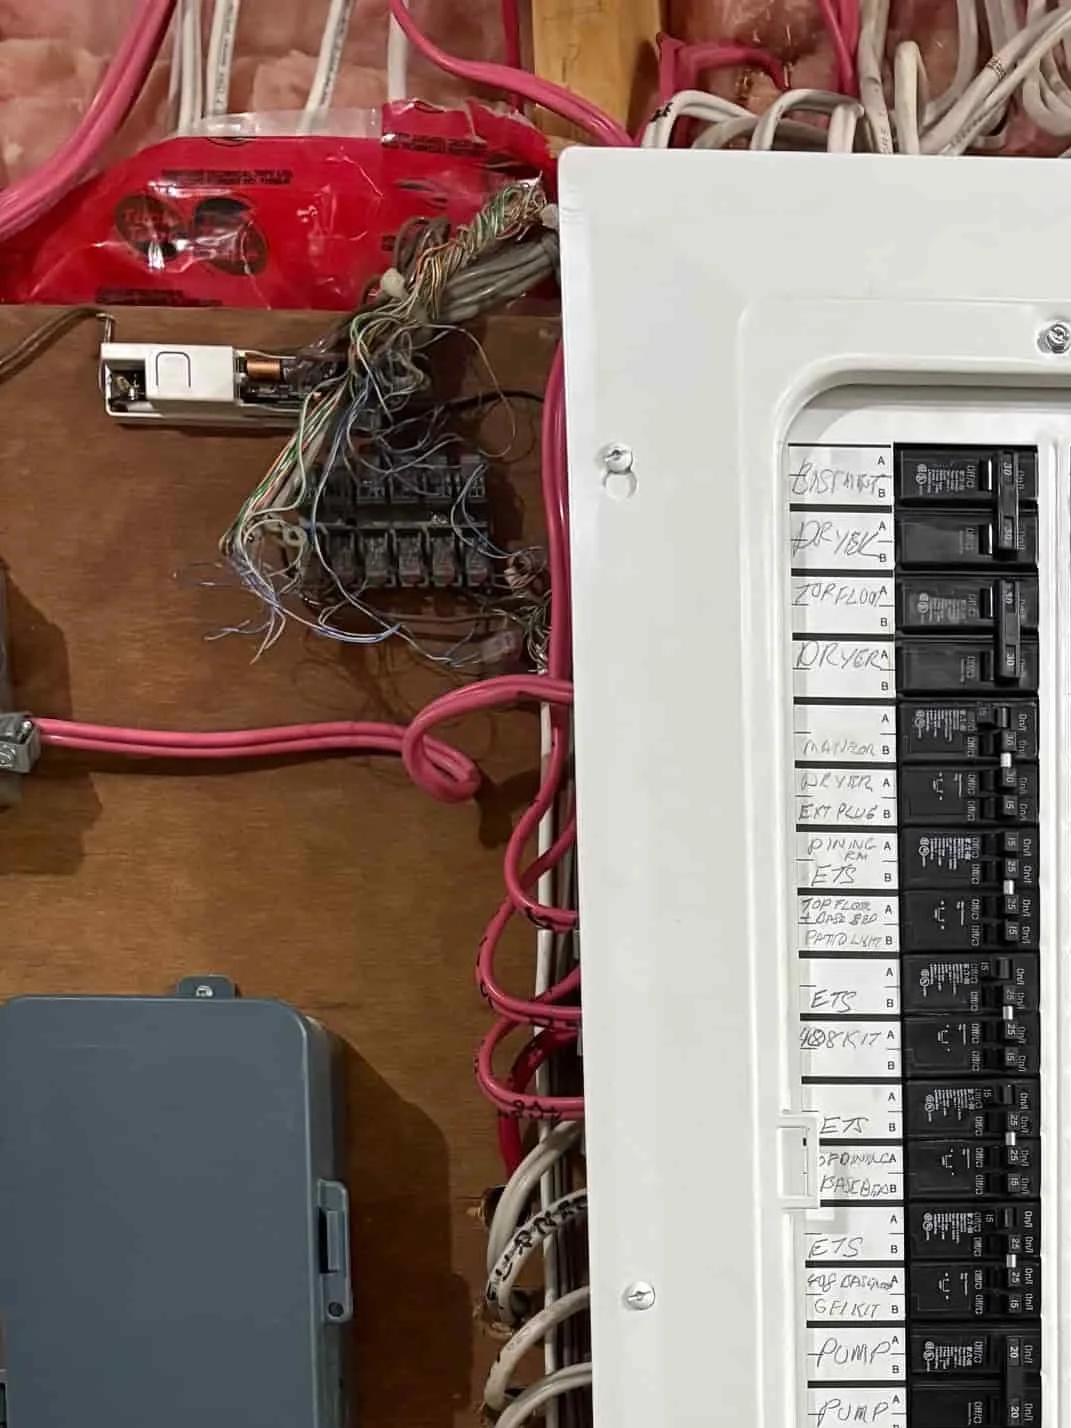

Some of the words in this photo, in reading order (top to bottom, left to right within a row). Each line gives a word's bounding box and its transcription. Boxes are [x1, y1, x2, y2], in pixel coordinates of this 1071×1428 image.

[878, 456, 885, 465] A
[878, 489, 885, 497] B
[881, 713, 889, 722] A
[882, 745, 889, 755] B
[798, 803, 832, 821] EXT
[837, 802, 878, 820] PLUG
[808, 837, 877, 855] DINING
[811, 864, 856, 886] ETS
[886, 968, 894, 976] A
[811, 989, 857, 1013] ETS
[886, 998, 894, 1008] B
[890, 1214, 897, 1224] A
[808, 1237, 863, 1258] ETS
[890, 1245, 898, 1253] B
[815, 1299, 848, 1315] GFI
[851, 1303, 880, 1318] KIT
[816, 1337, 891, 1368] PUMP
[1010, 1346, 1018, 1358] 20
[817, 1399, 889, 1428] PUMP
